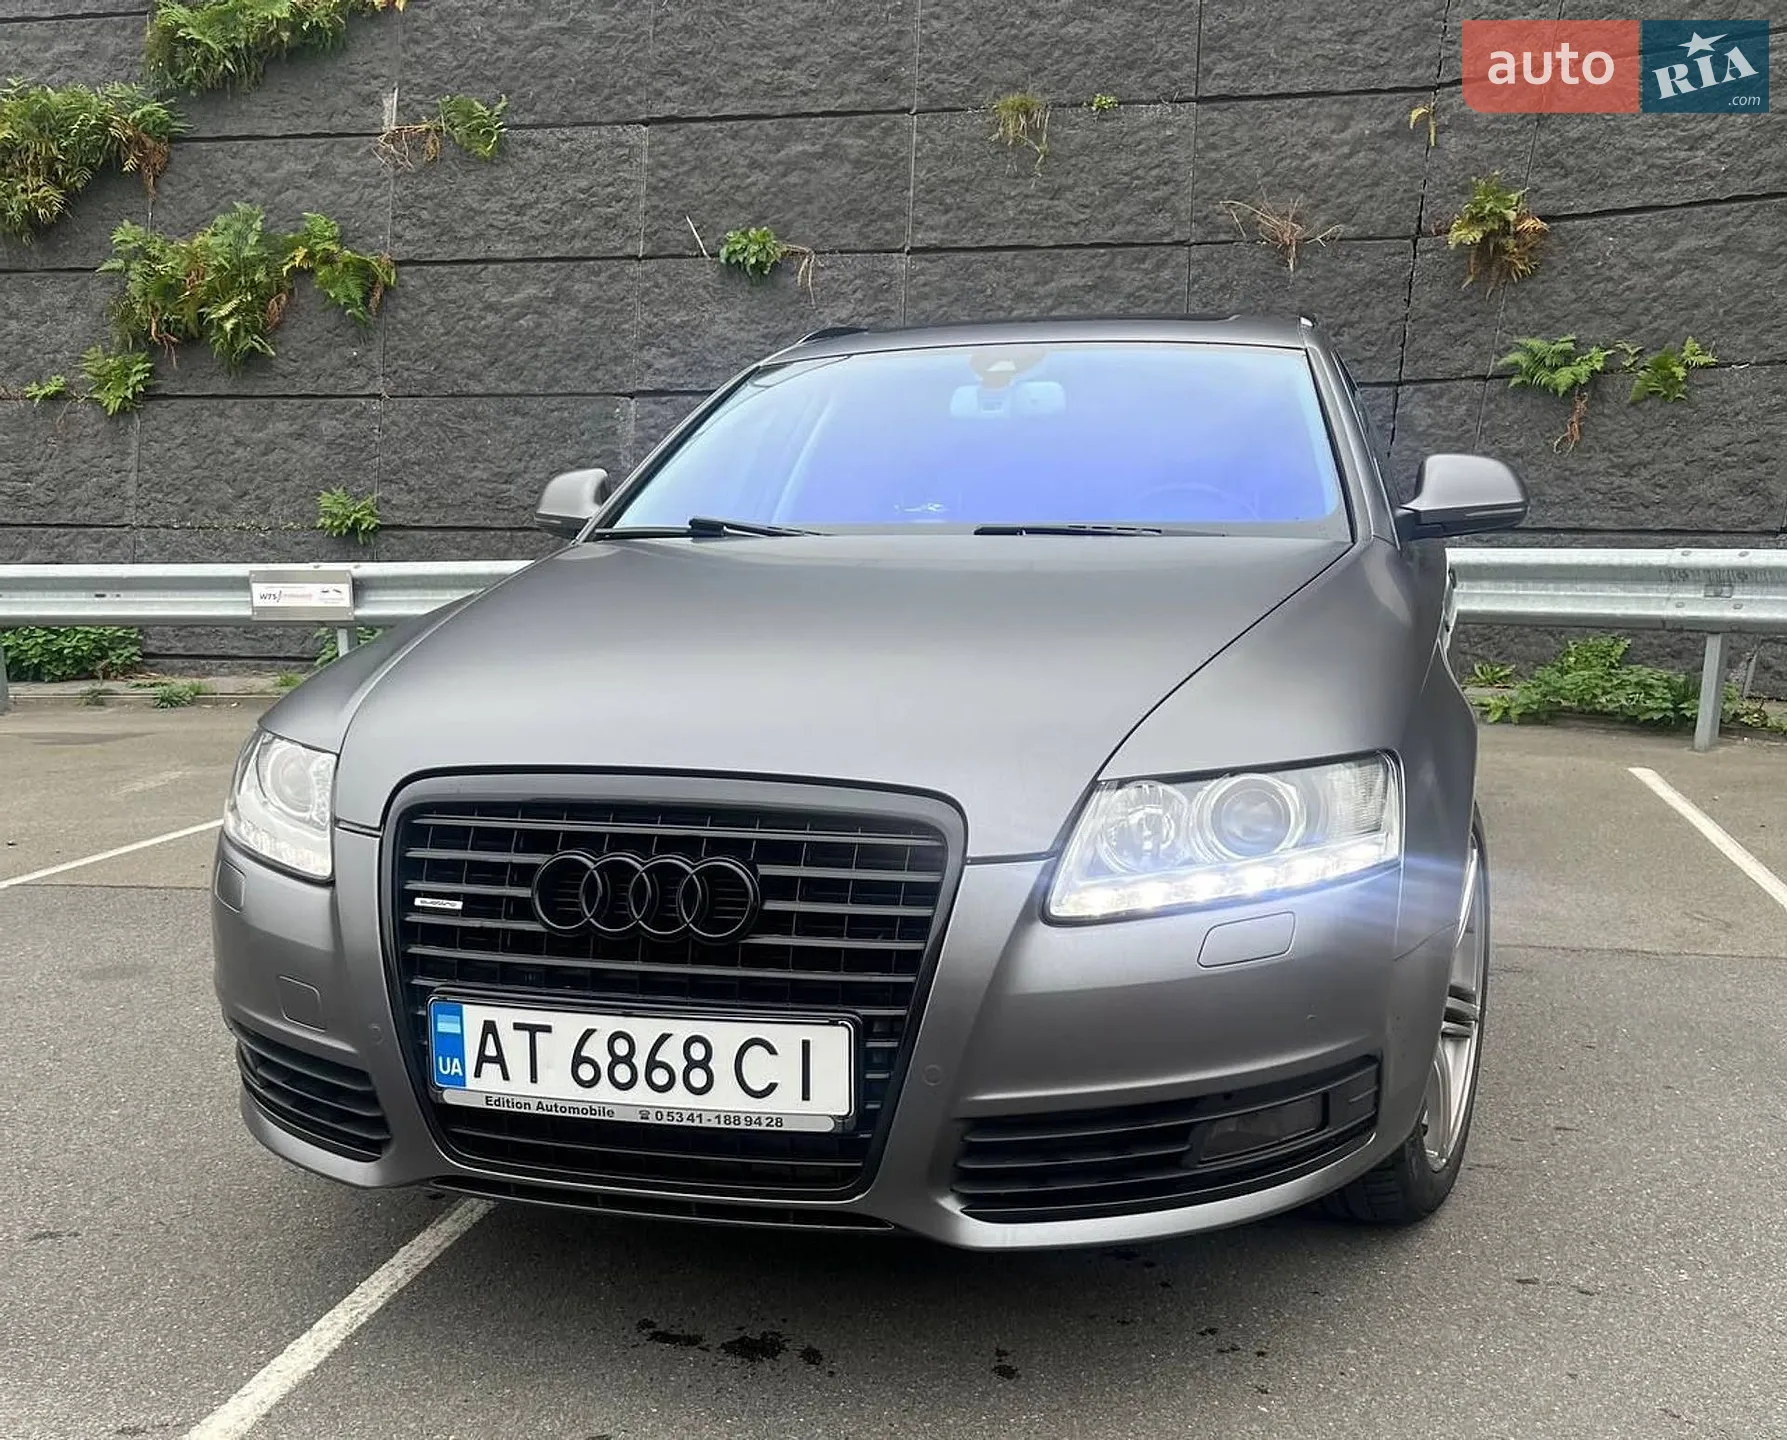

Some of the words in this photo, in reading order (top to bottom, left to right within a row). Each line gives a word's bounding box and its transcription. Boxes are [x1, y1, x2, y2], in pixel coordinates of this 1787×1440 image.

[438, 1057, 464, 1077] UA
[473, 1019, 553, 1085] AT
[570, 1027, 716, 1096] 6868
[733, 1036, 811, 1102] CI
[485, 1095, 532, 1110] Edition
[535, 1100, 615, 1118] Automobile
